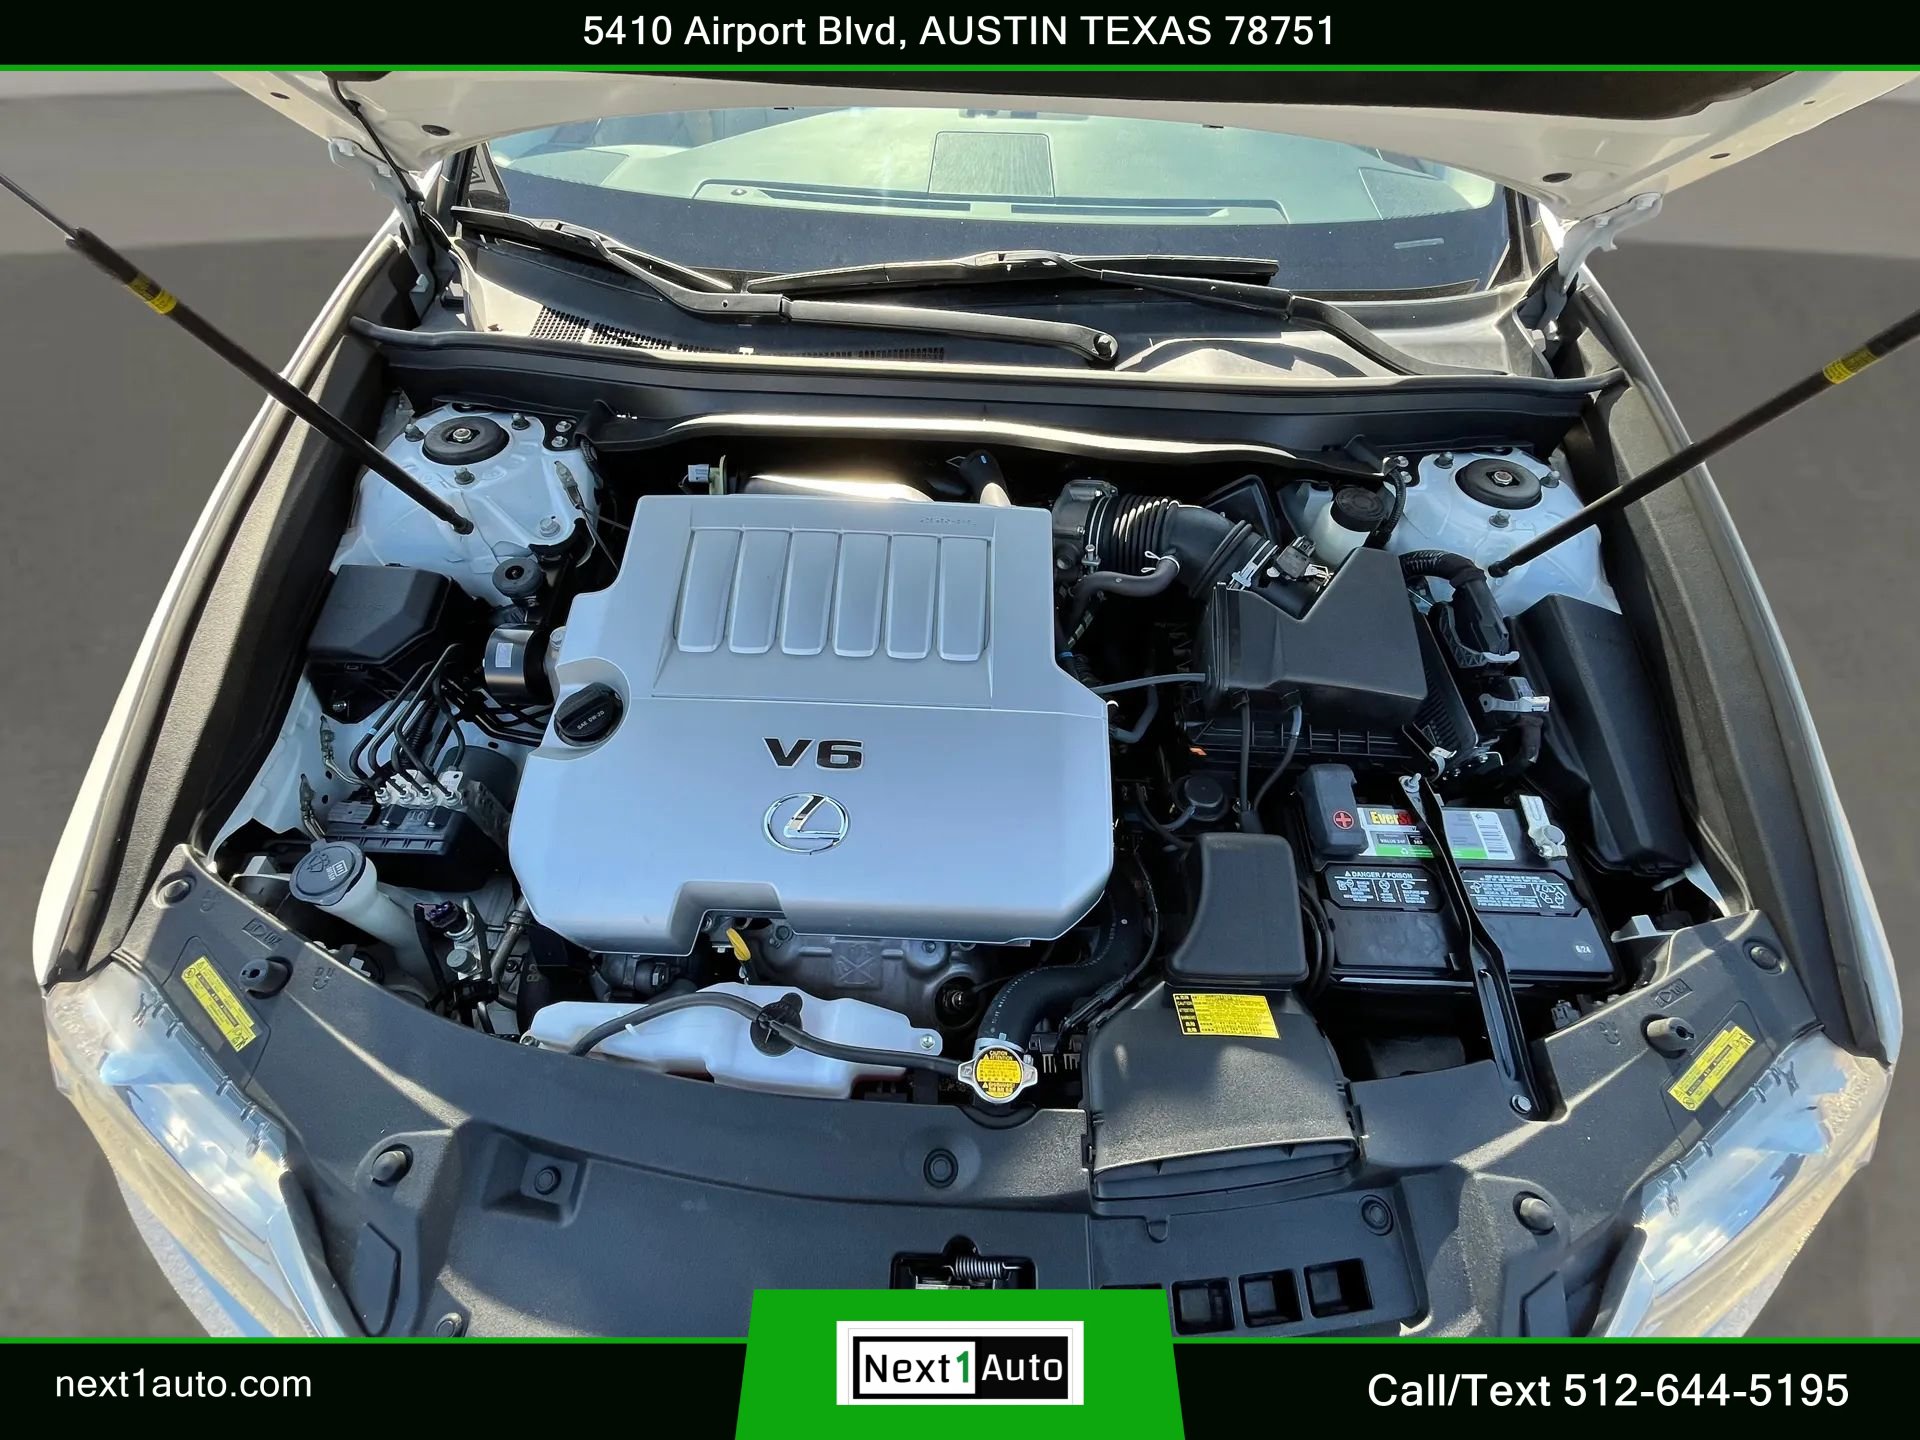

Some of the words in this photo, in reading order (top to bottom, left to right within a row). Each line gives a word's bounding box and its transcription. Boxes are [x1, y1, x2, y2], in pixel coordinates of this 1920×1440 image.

[764, 737, 864, 769] V6
[1351, 870, 1381, 878] DANGER
[1386, 871, 1414, 879] POISON
